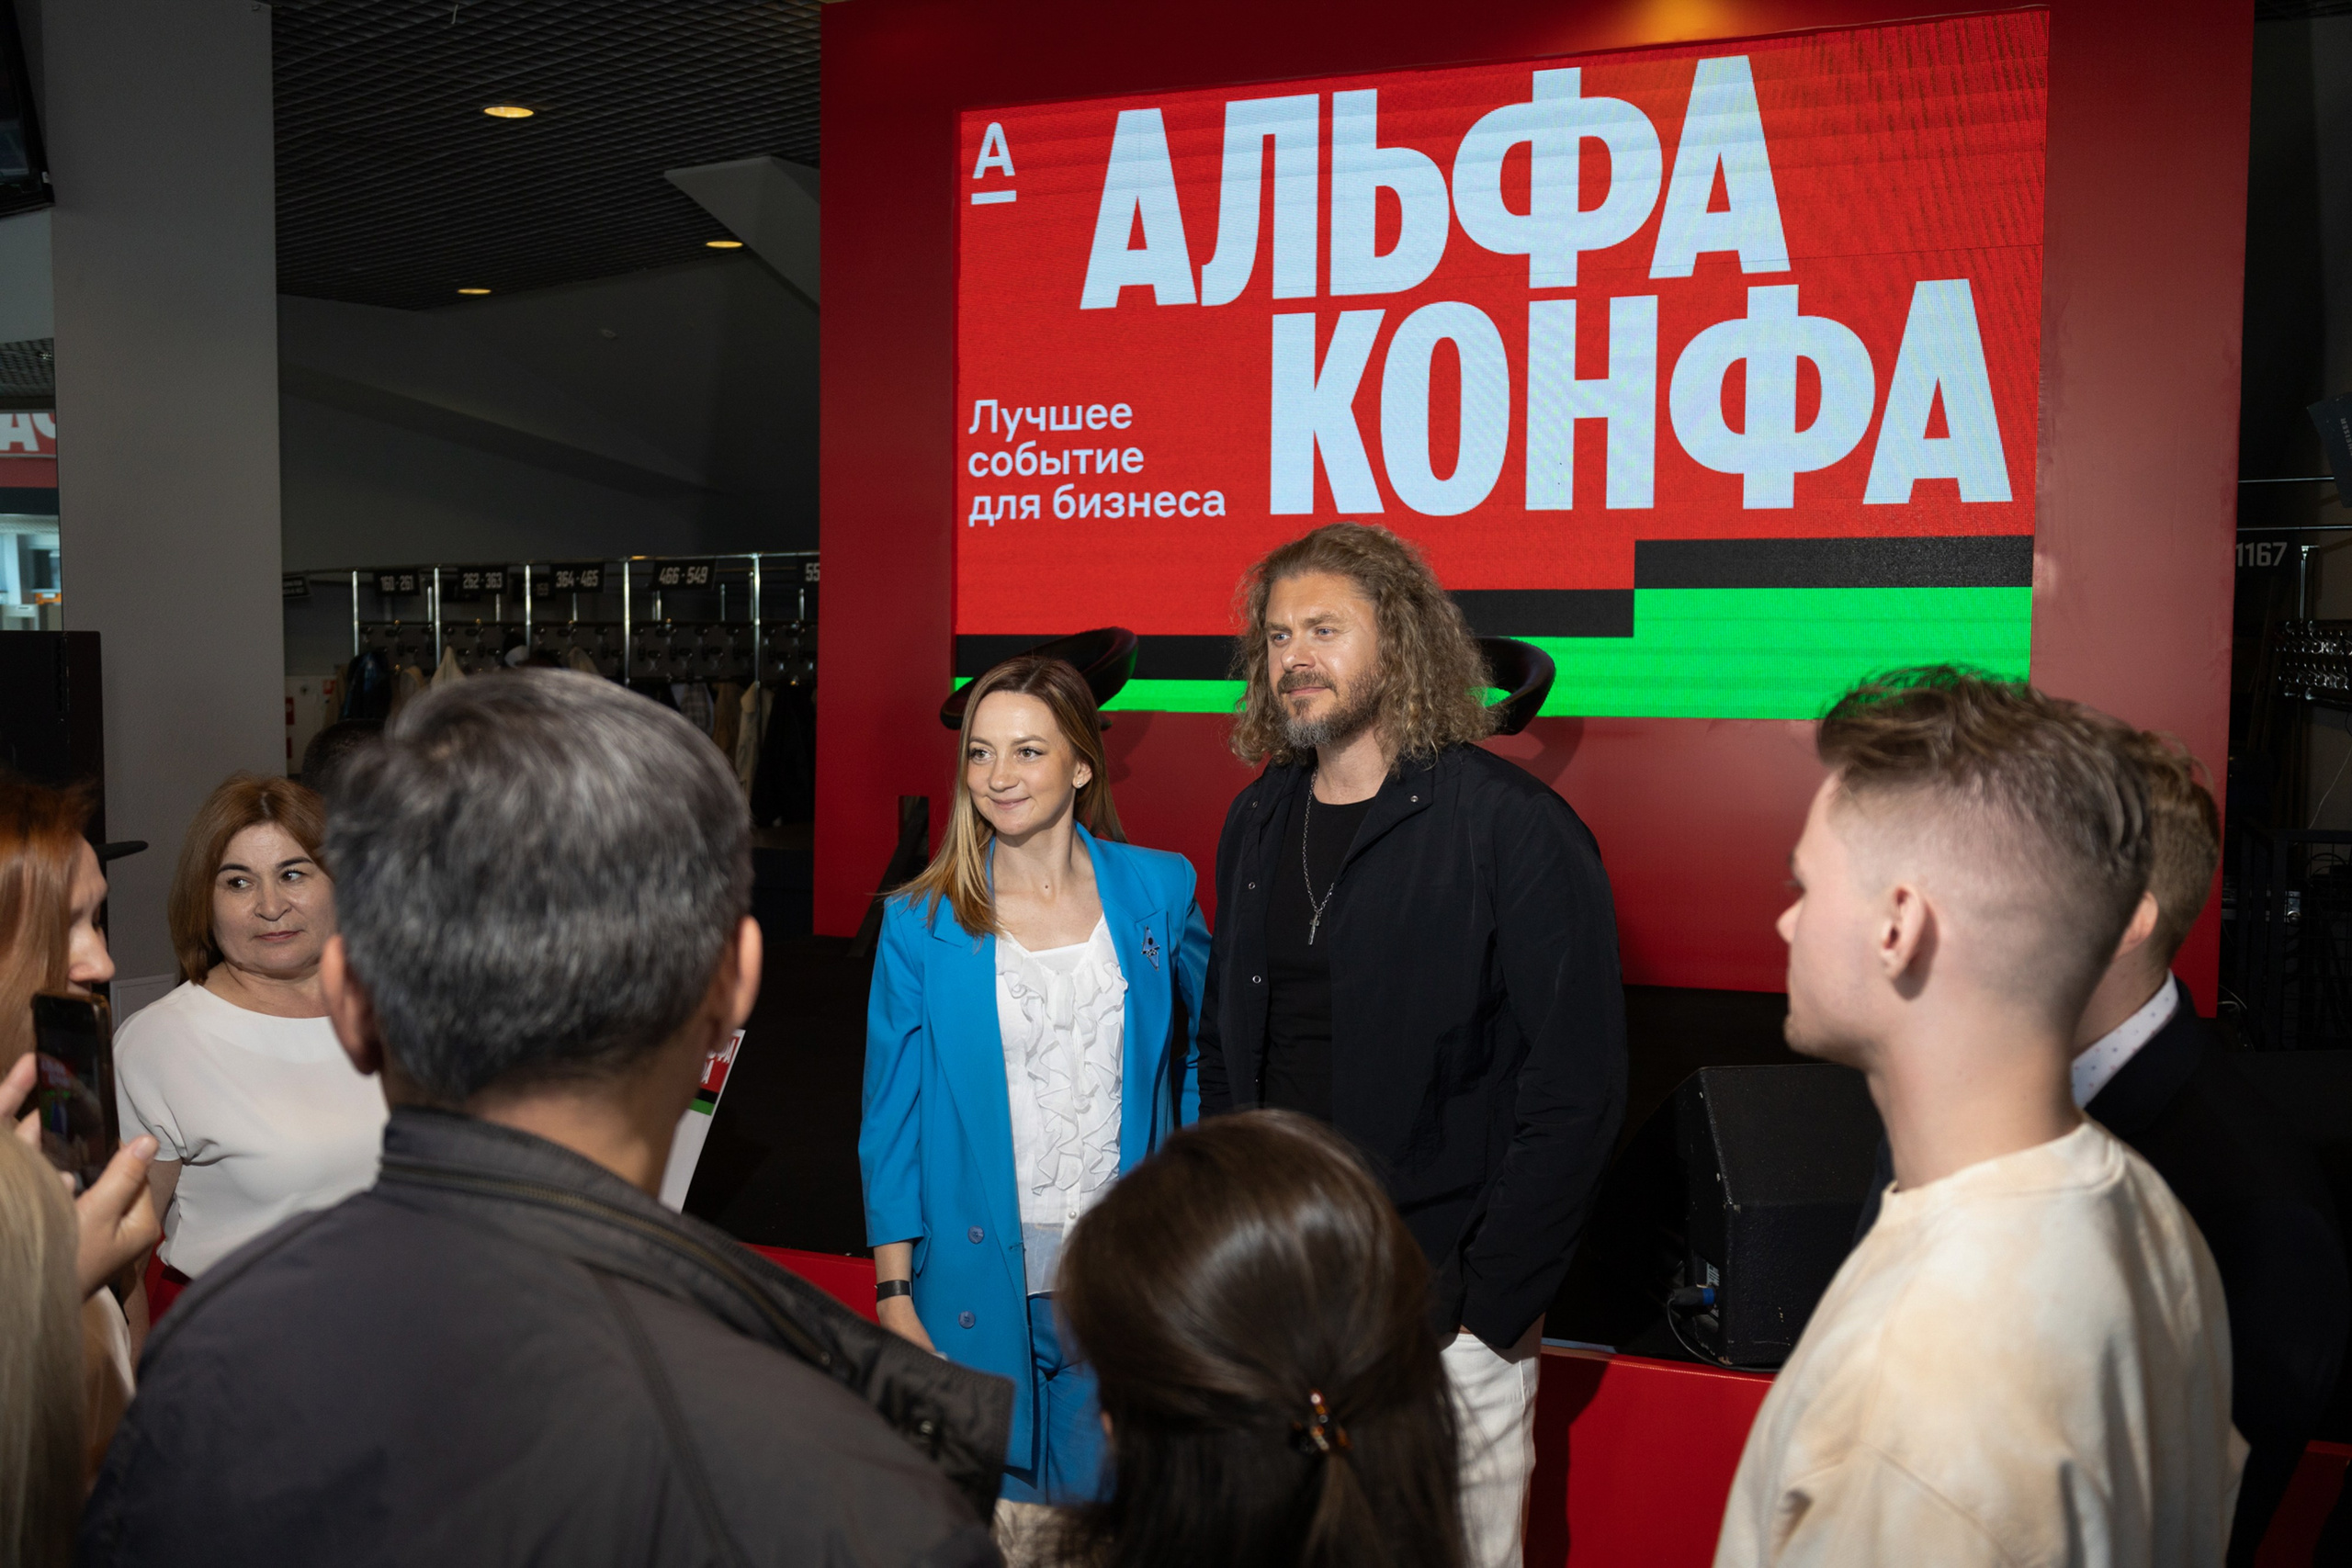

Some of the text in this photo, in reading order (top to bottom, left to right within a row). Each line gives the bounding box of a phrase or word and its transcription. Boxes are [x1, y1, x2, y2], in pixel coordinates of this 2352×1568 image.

[972, 121, 1016, 179] А
[1080, 55, 1791, 310] АЛЬФА
[1271, 279, 2013, 516] КОНФА
[968, 399, 1133, 442] Лучшее
[967, 441, 1145, 477] событие
[968, 483, 1227, 526] для бизнеса
[2236, 542, 2288, 567] 1167
